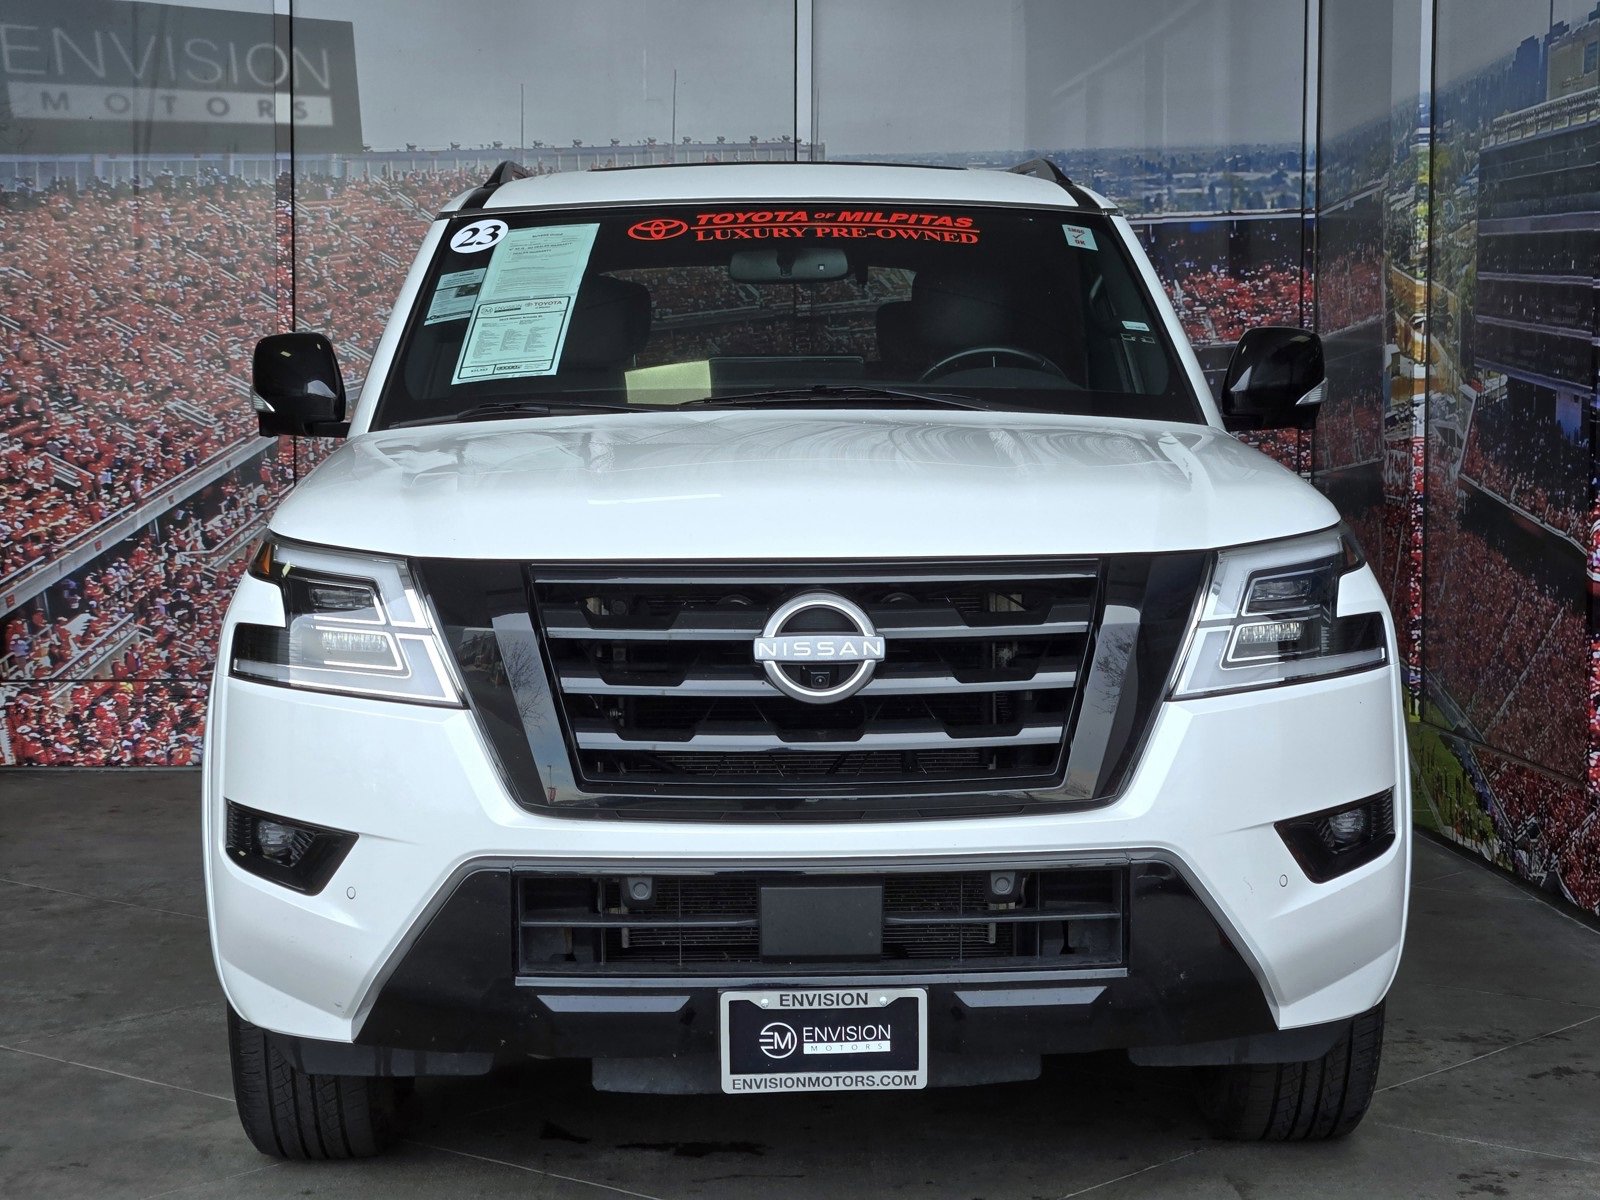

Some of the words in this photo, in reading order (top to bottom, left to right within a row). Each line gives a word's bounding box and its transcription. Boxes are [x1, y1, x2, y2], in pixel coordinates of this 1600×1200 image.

[0, 23, 331, 91] ENVISION
[41, 90, 309, 121] MOTORS
[696, 211, 808, 225] TOYOTA
[840, 211, 973, 227] MILPITAS
[455, 225, 502, 248] 23
[695, 227, 809, 242] LUXURY
[815, 227, 980, 244] PRE-OWNED
[758, 641, 881, 656] NISSAN
[779, 992, 869, 1007] ENVISION
[803, 1024, 891, 1042] ENVISION
[810, 1042, 883, 1052] MOTORS
[732, 1074, 917, 1090] ENVISIONMOTORS.COM
